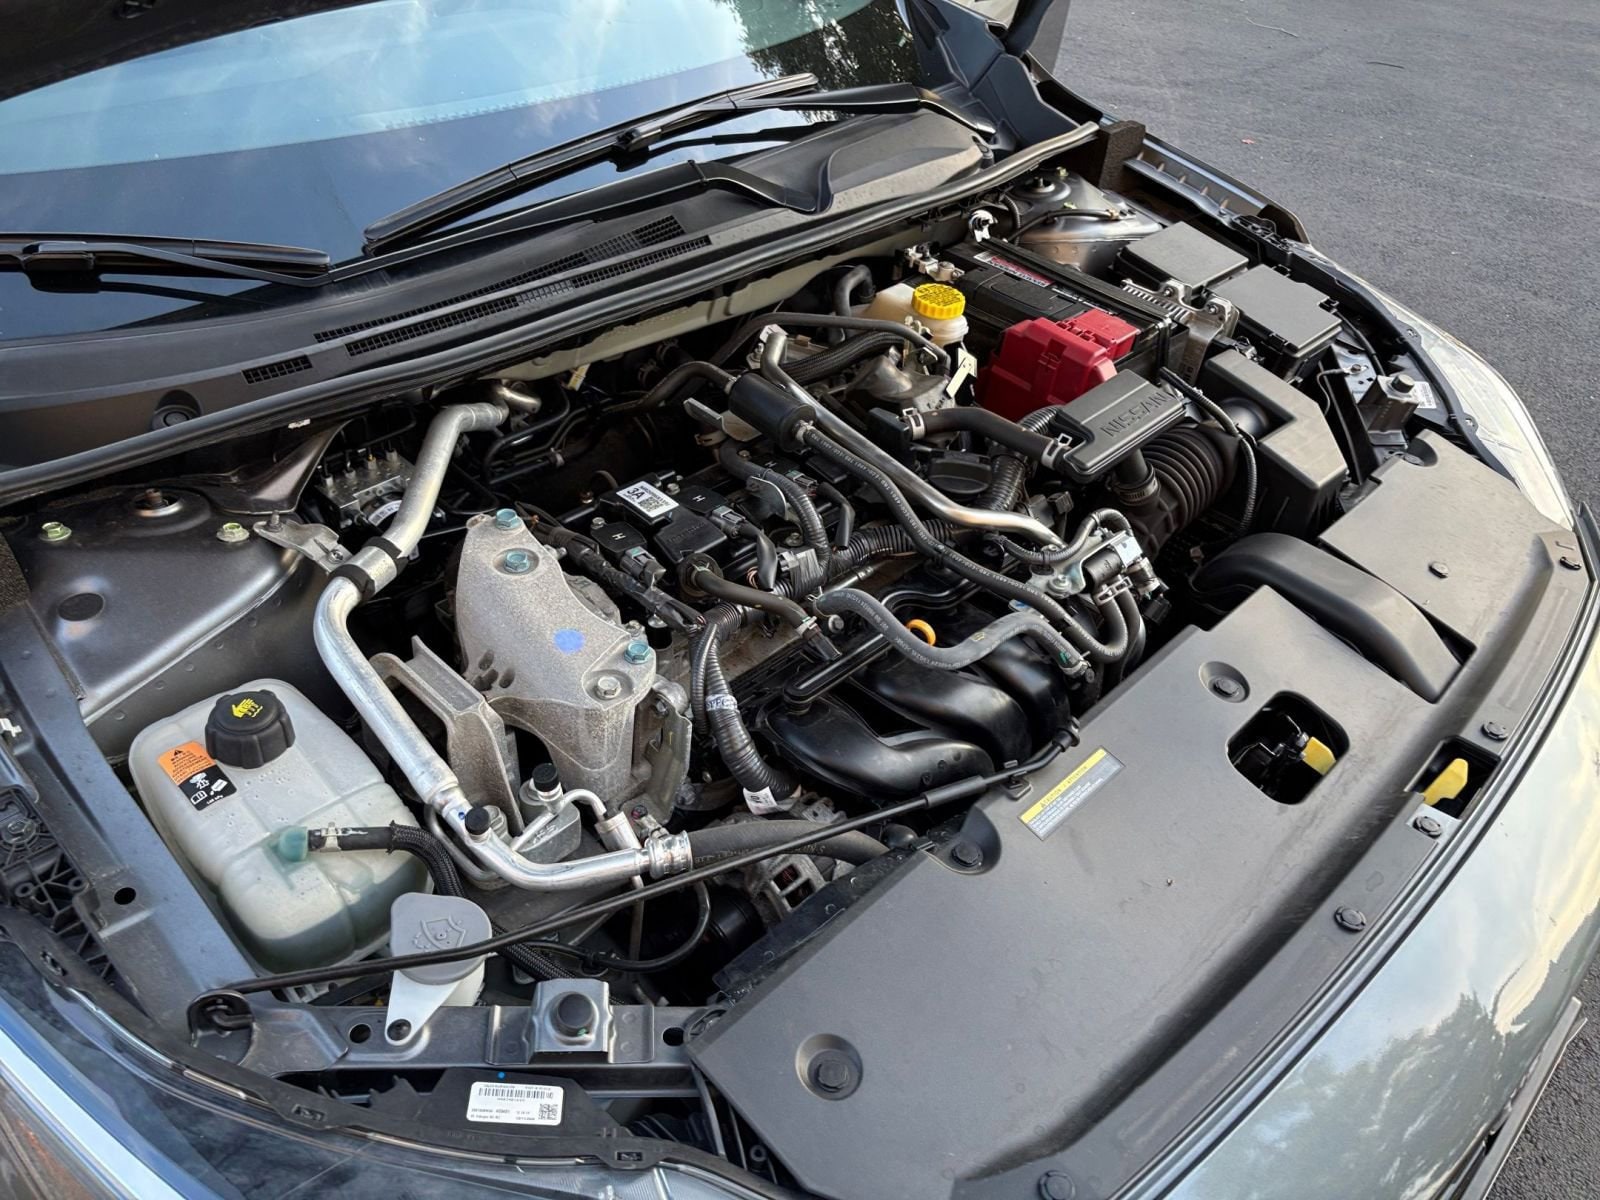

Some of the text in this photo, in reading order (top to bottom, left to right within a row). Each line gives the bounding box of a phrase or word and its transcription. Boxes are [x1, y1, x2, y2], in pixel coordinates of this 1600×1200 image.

[1100, 391, 1168, 437] NISSAN
[626, 487, 646, 500] 3A
[692, 494, 706, 503] H
[611, 532, 626, 541] H
